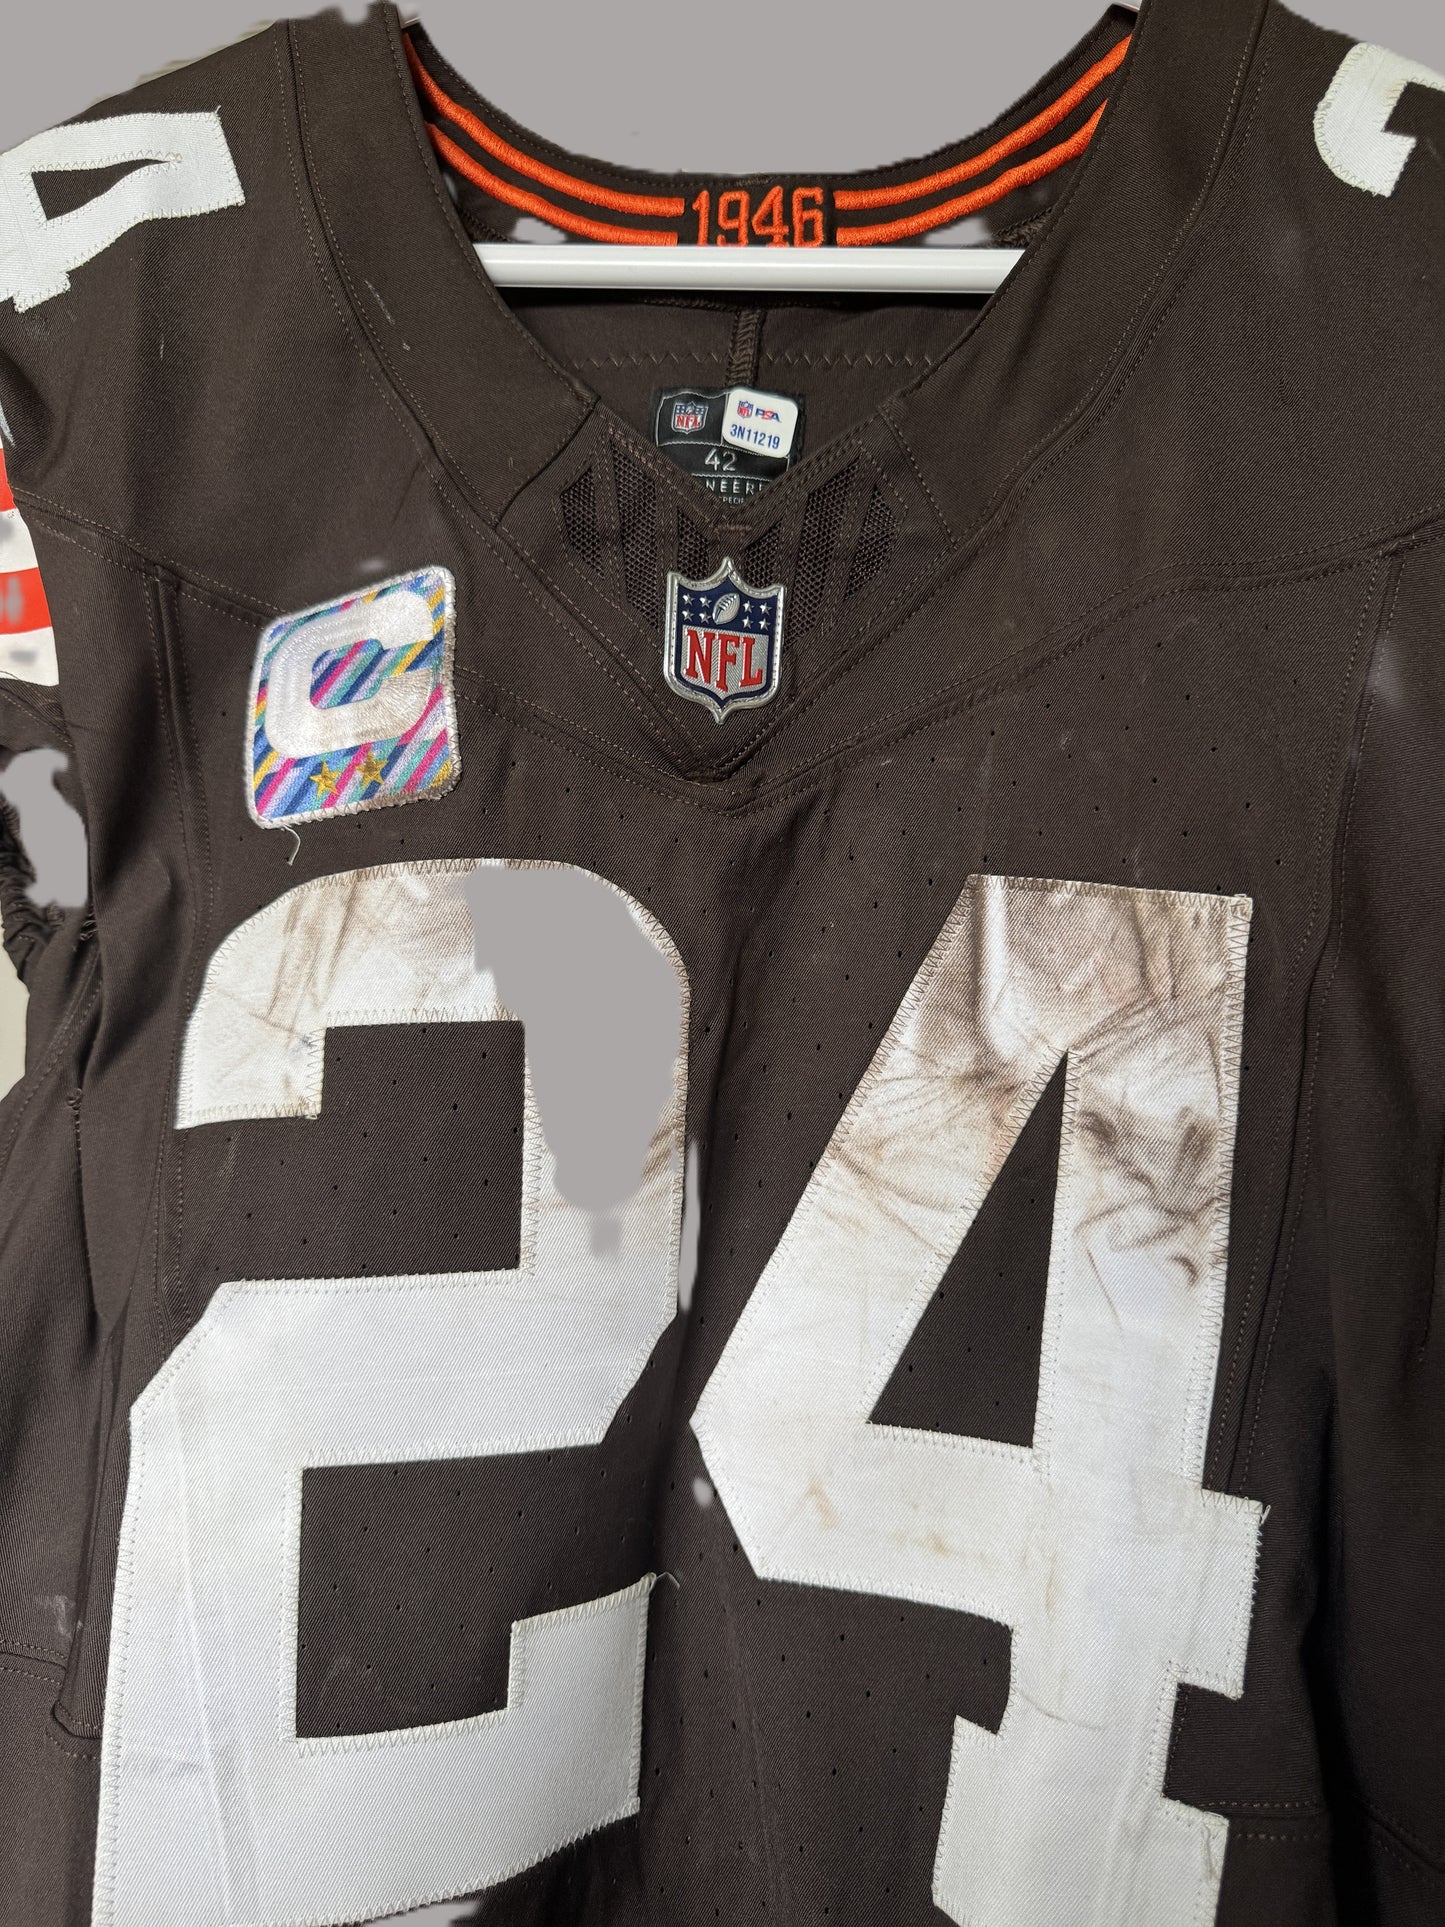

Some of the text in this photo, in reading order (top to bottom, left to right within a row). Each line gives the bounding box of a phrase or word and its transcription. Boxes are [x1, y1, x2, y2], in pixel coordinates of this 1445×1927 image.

[692, 186, 825, 248] 1946
[676, 414, 702, 429] NFL
[730, 424, 780, 449] 3N11219
[755, 408, 780, 422] PSA
[704, 448, 736, 471] 42
[264, 590, 434, 760] C
[684, 629, 764, 693] NFL
[91, 856, 1268, 1927] 24
